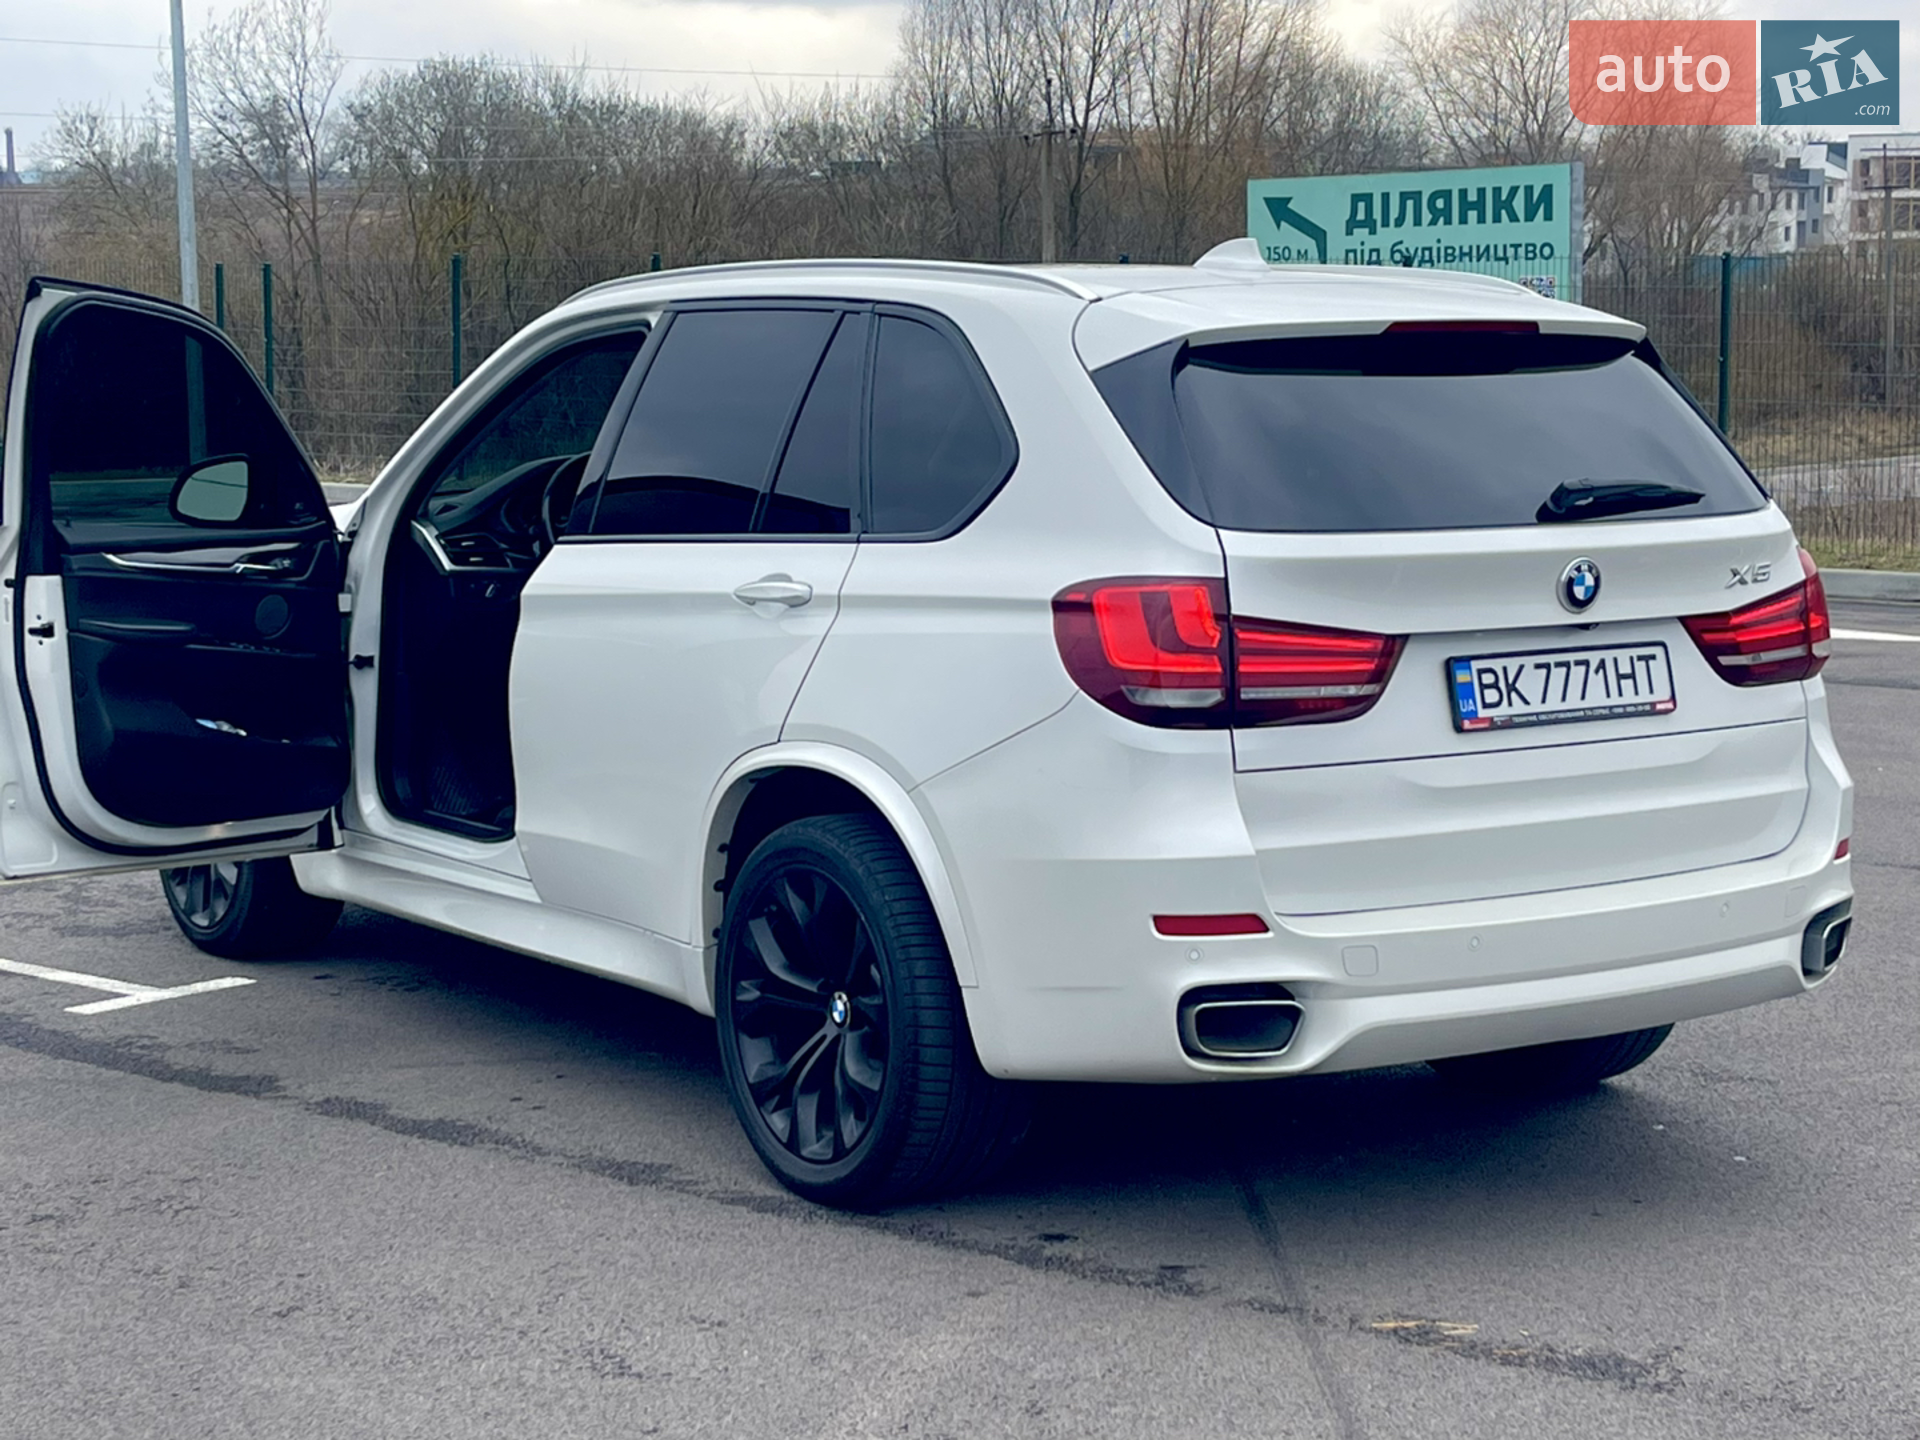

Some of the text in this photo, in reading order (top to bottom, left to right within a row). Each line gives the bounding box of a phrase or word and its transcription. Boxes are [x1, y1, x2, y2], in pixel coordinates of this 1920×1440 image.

[1345, 184, 1554, 236] ДІЛЯНКИ
[1266, 245, 1292, 262] 150
[1345, 238, 1554, 268] під будівництво
[1725, 562, 1771, 589] X5
[1460, 699, 1476, 713] UA
